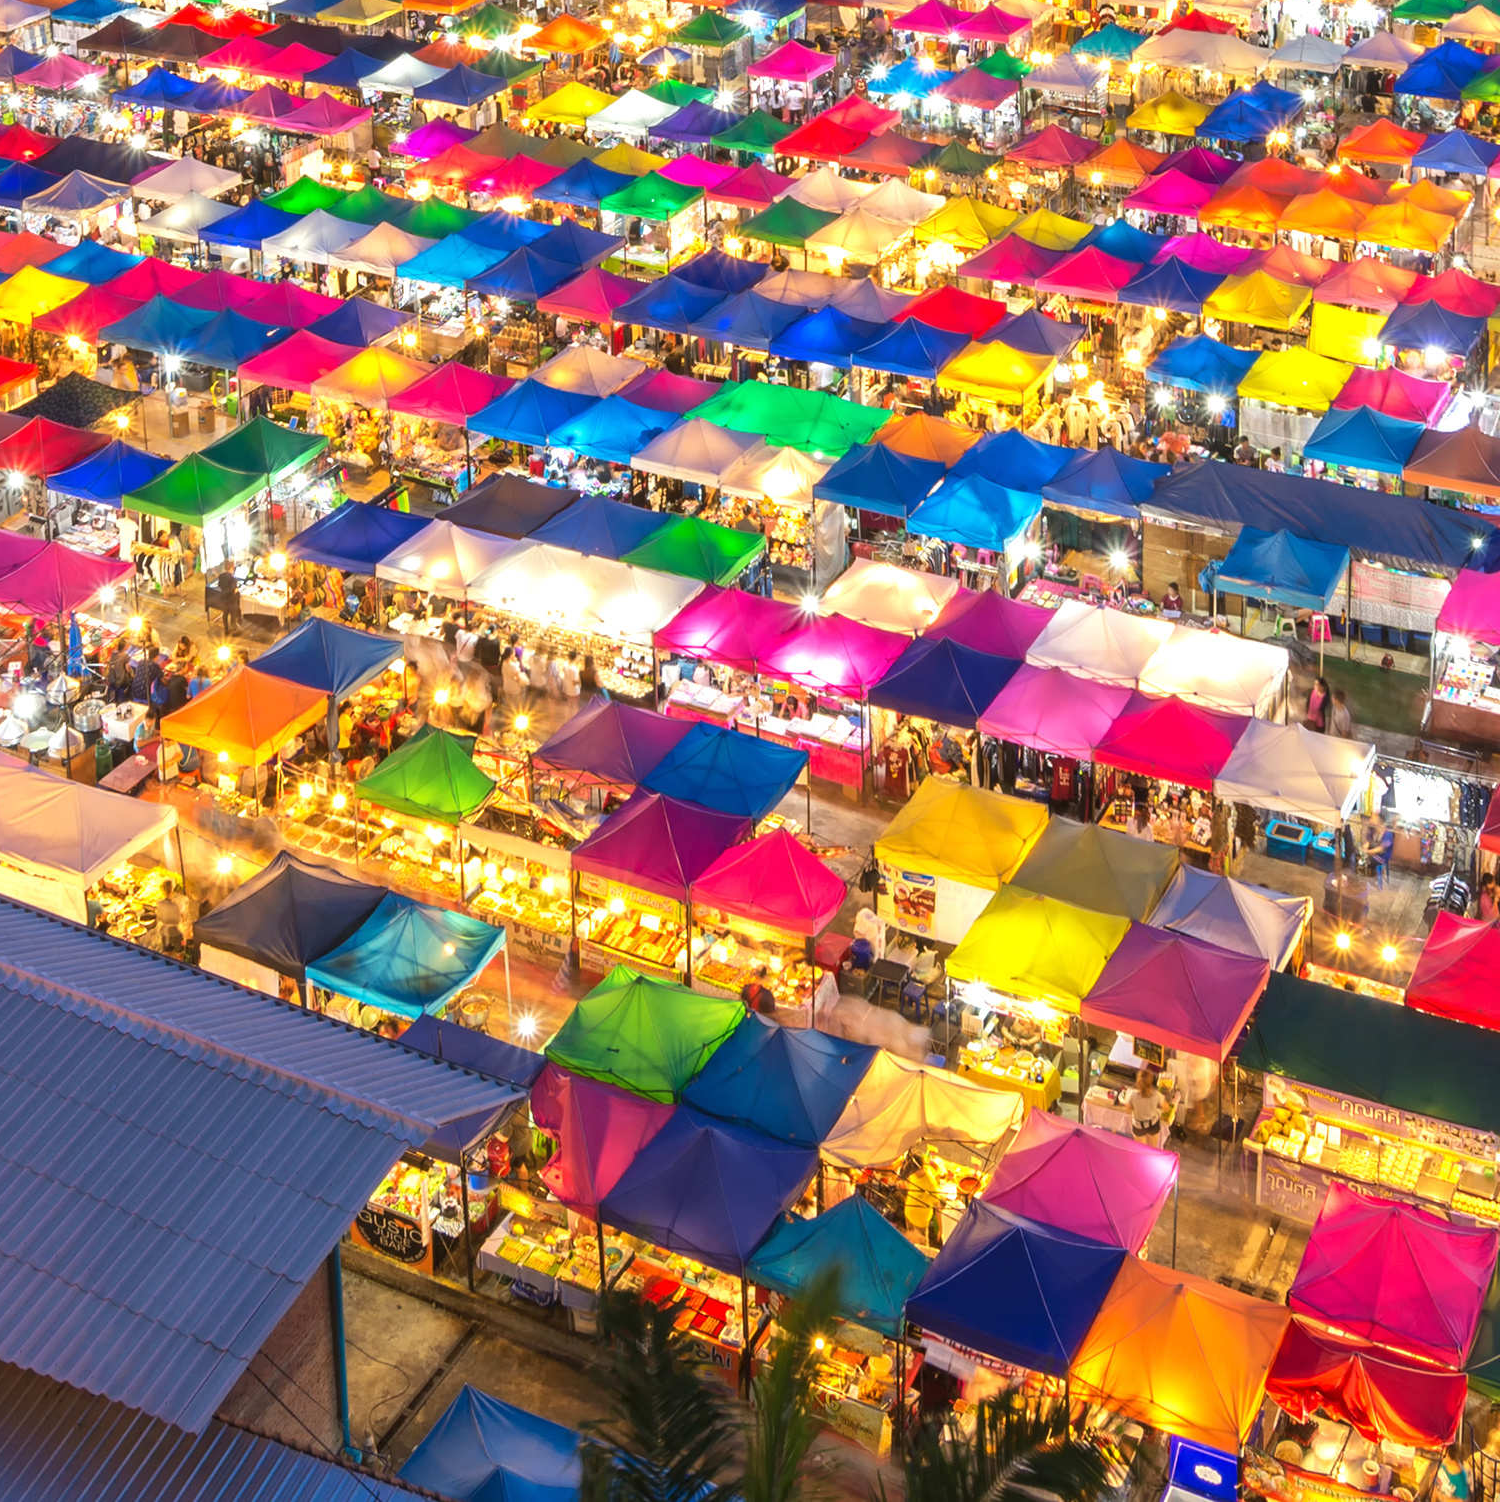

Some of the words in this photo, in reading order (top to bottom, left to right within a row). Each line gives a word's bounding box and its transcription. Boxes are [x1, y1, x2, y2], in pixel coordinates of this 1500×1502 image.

[1341, 1098, 1402, 1126] คุณศศิ
[1265, 1173, 1318, 1202] คุณศศิ
[358, 1209, 423, 1245] GUSTO
[373, 1227, 412, 1249] JUICE
[379, 1236, 406, 1255] BAR
